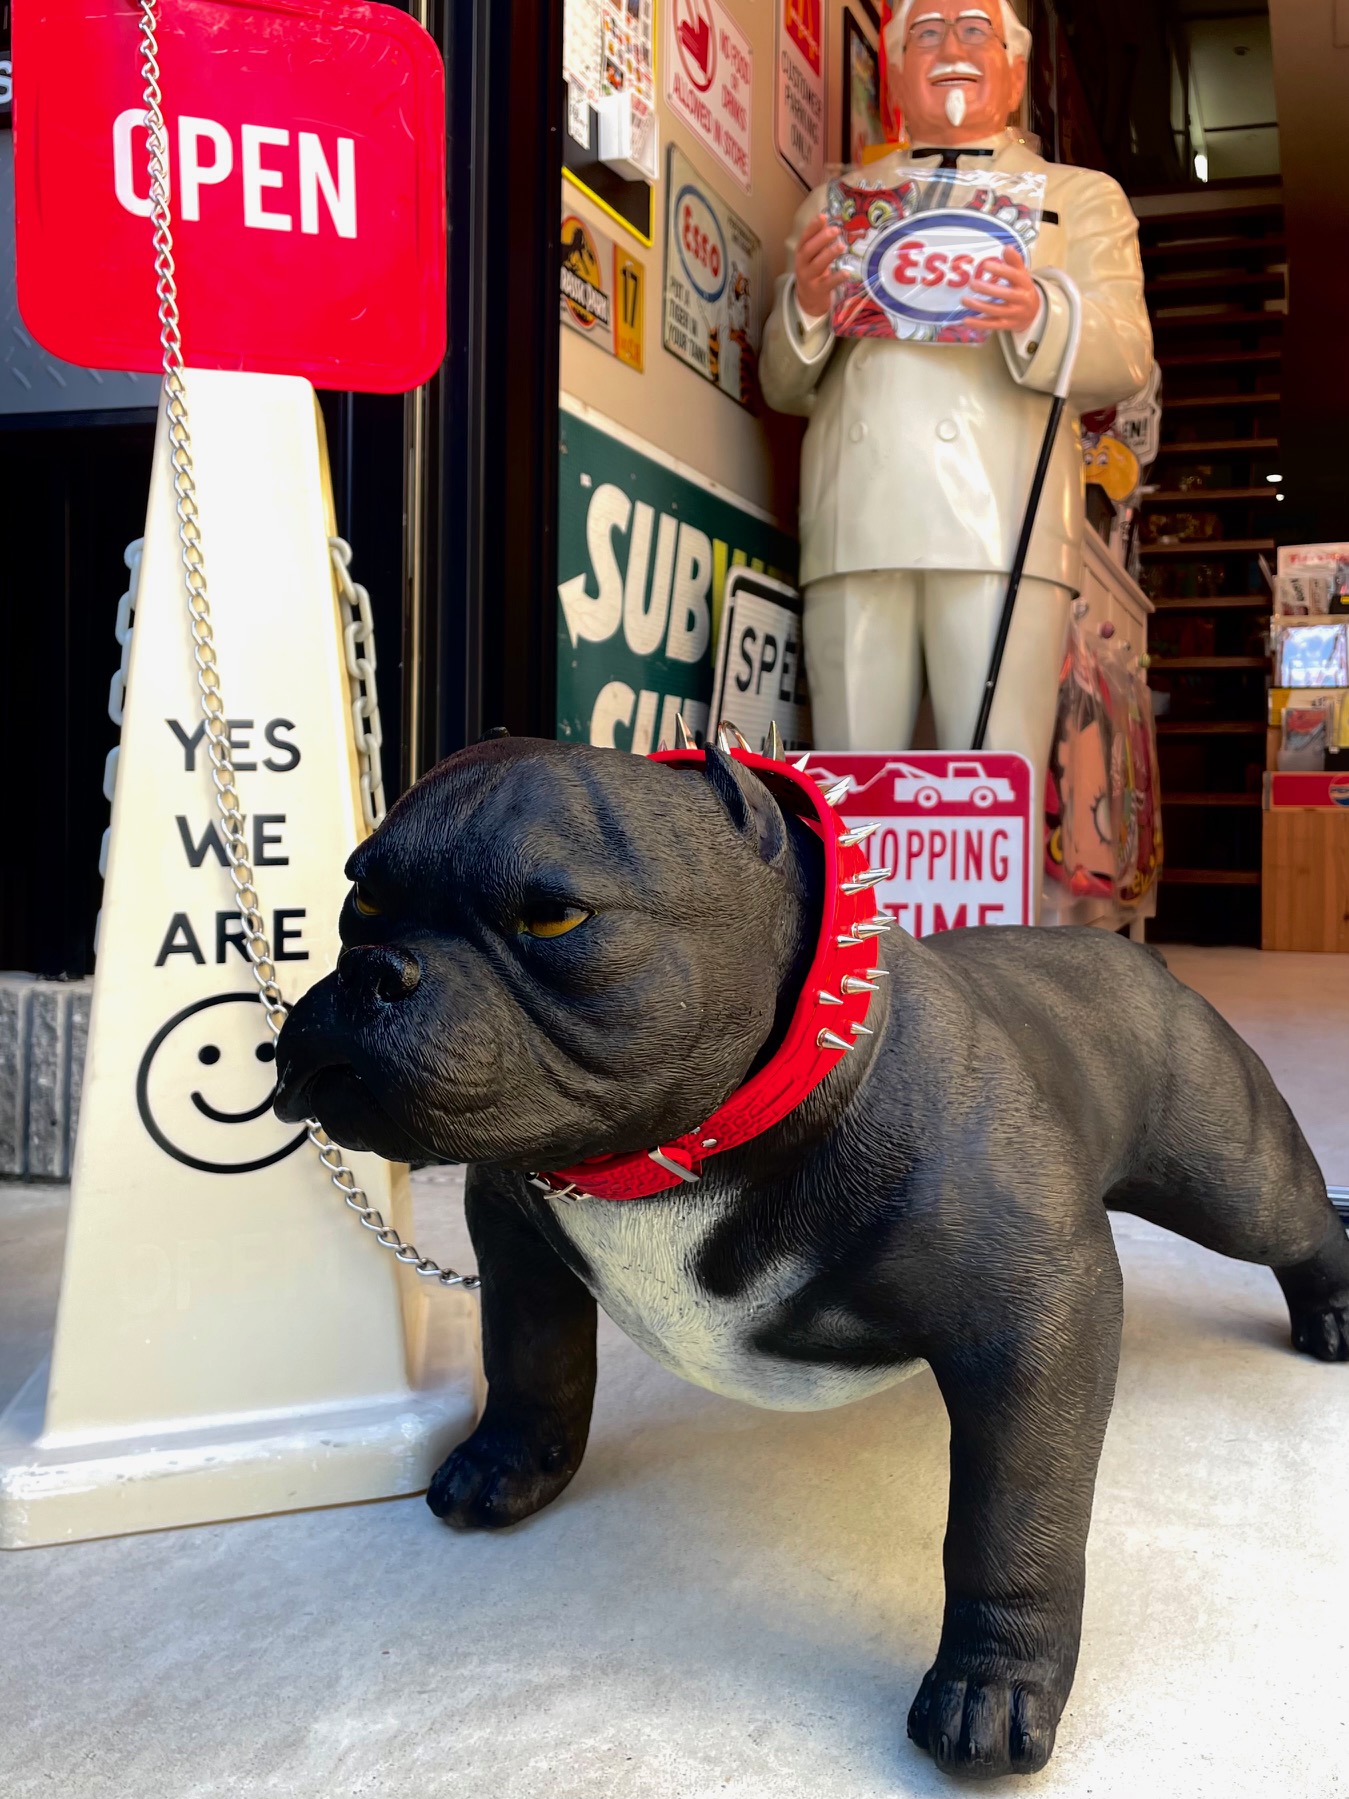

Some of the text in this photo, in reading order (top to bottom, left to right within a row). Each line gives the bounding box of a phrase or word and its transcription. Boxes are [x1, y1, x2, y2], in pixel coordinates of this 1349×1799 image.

[673, 72, 711, 134] ALLOWED
[724, 130, 749, 177] STORE
[112, 108, 358, 239] OPEN
[165, 718, 301, 772] YES
[175, 814, 290, 868] WE
[863, 828, 1010, 882] TOPPING
[155, 908, 310, 967] ARE
